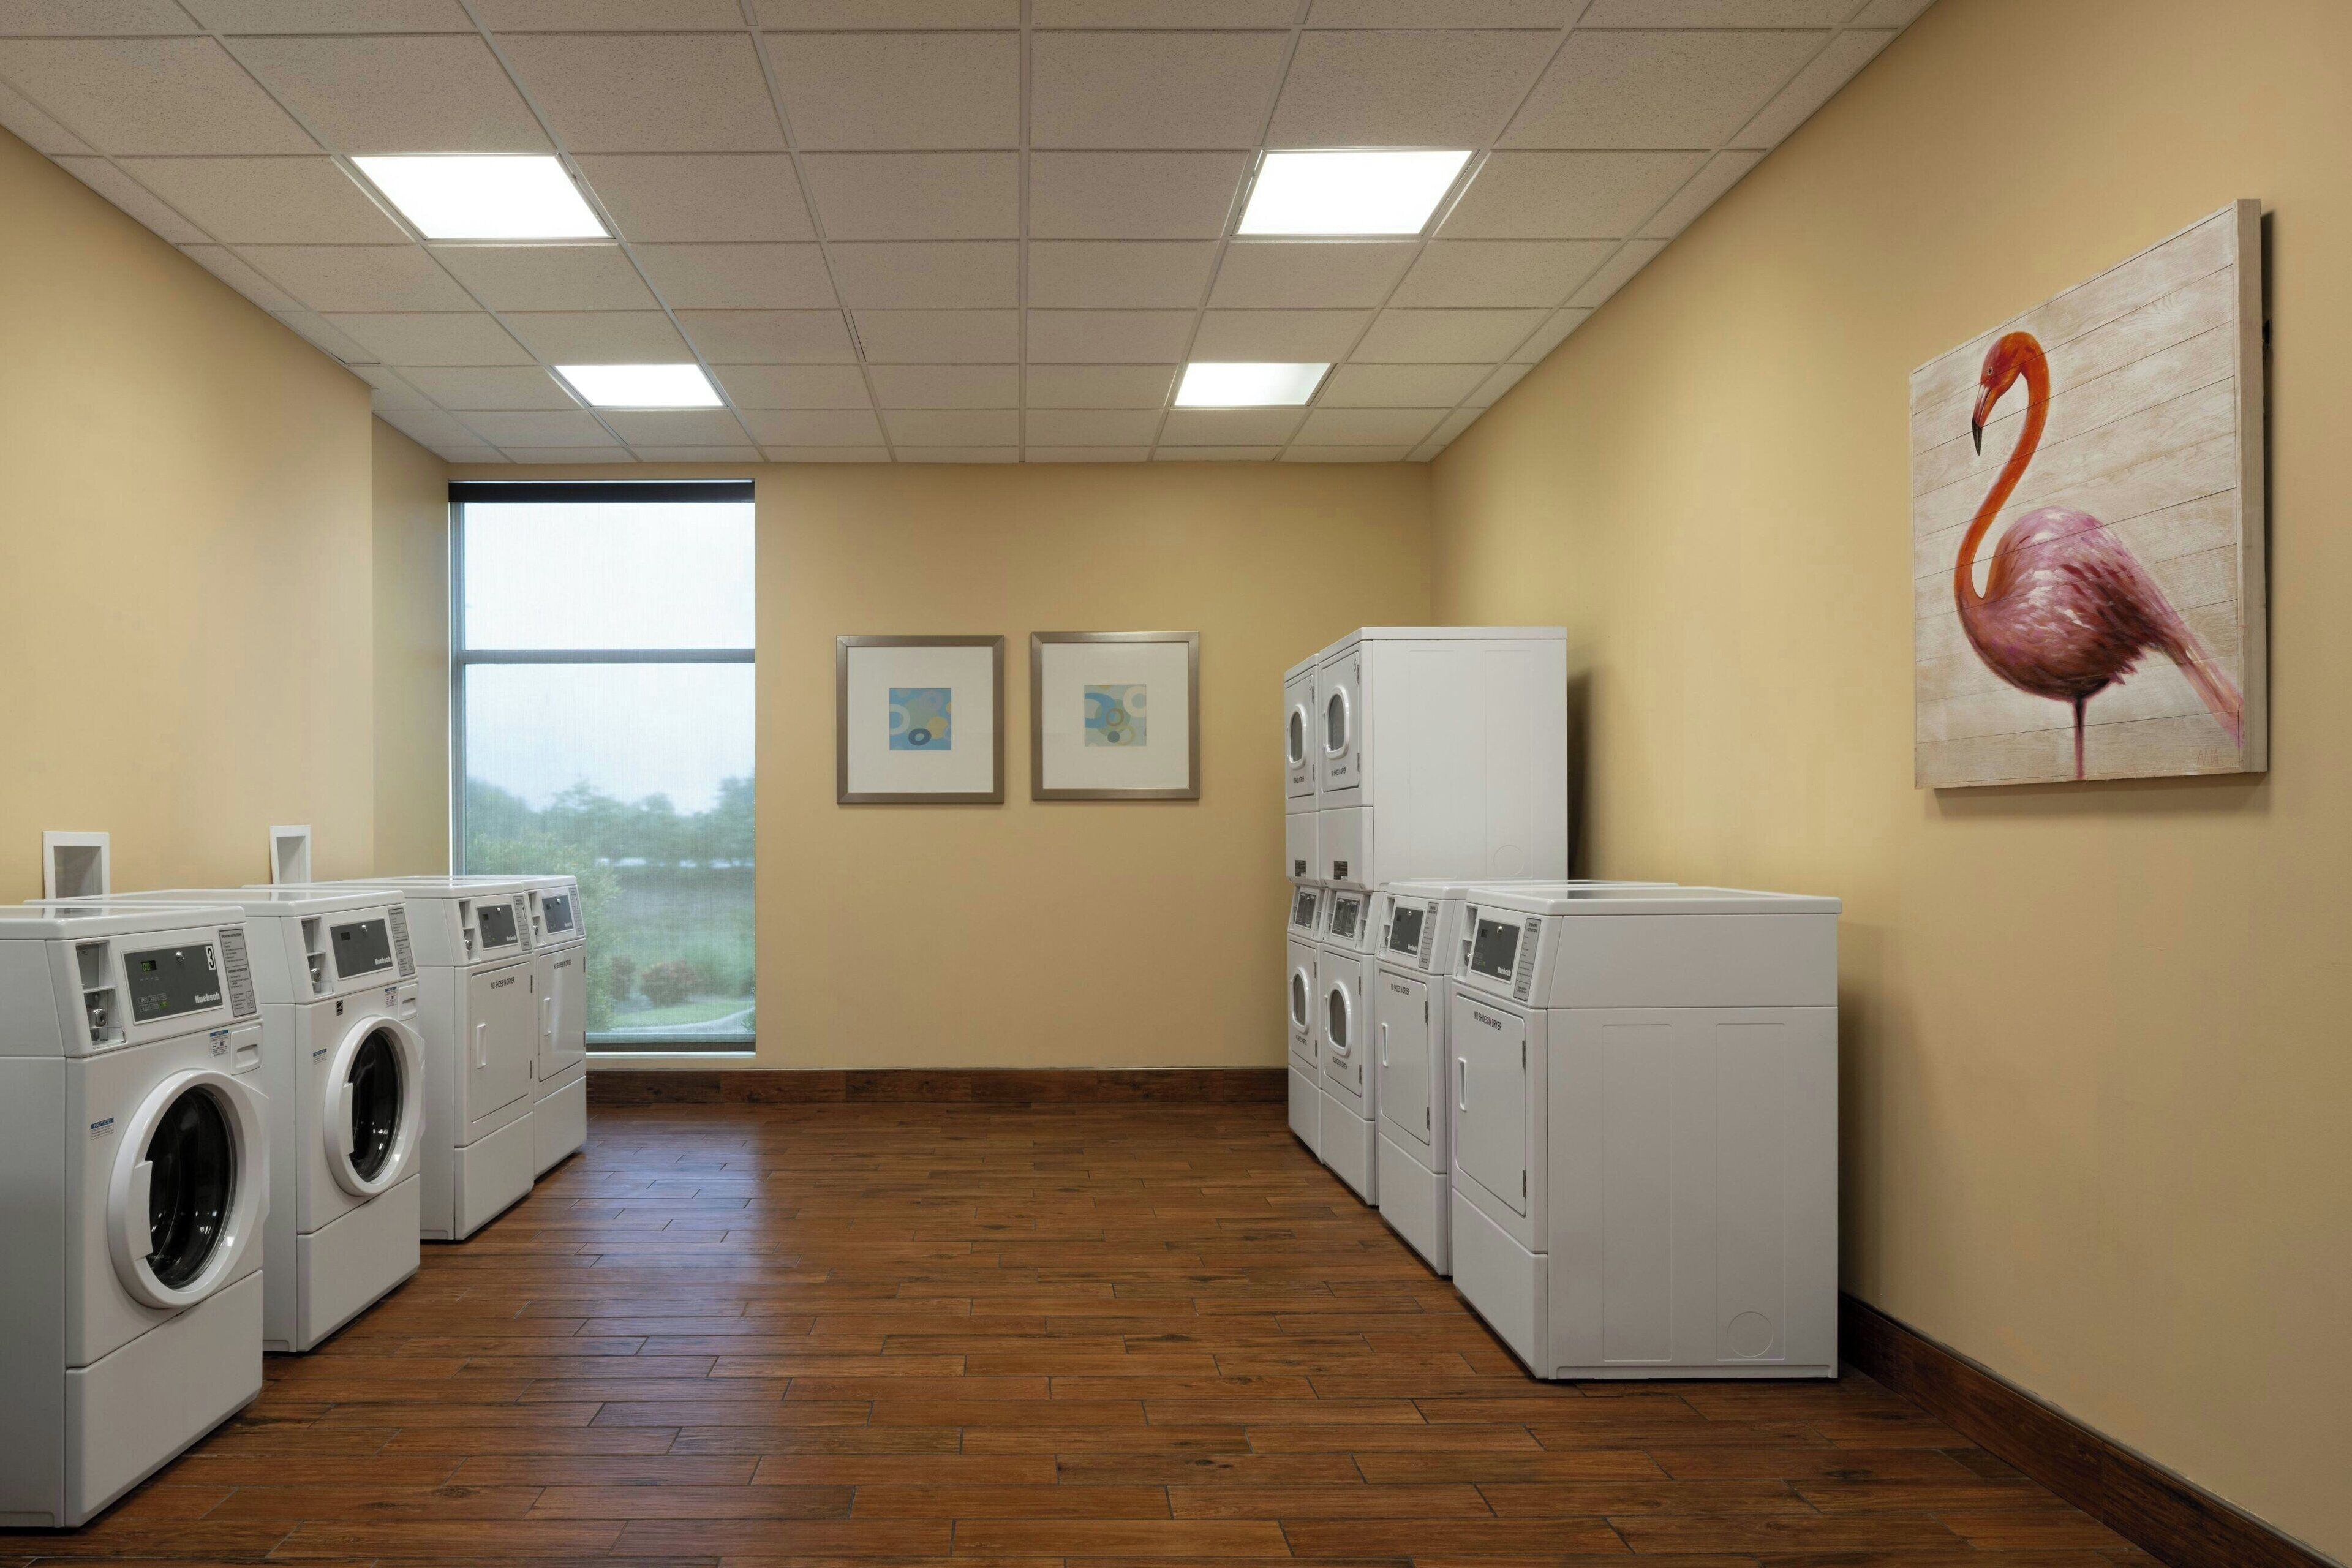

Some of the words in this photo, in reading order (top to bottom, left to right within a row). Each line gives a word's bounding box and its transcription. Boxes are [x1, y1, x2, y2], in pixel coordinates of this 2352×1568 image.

[207, 947, 214, 968] 3
[195, 992, 220, 1003] Huebsch
[1474, 1011, 1478, 1020] NO
[1479, 1012, 1488, 1024] SHOES
[1492, 1019, 1502, 1031] DRYER
